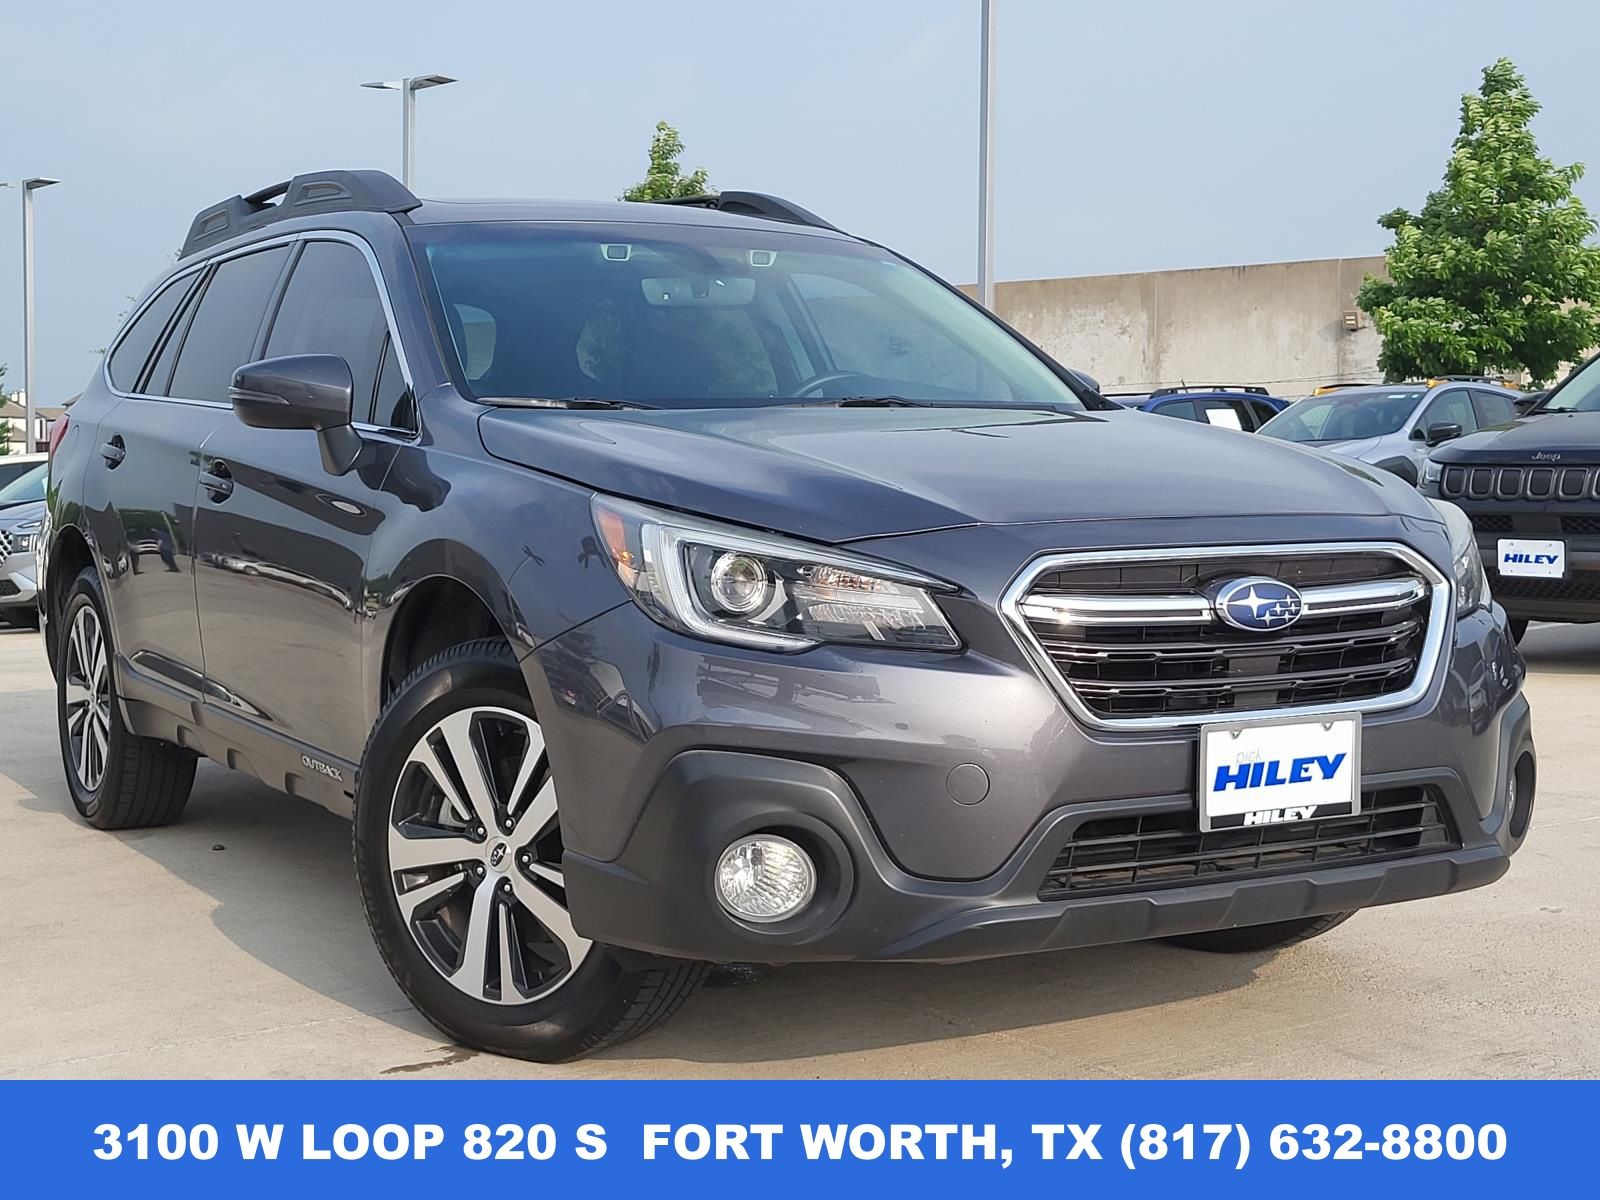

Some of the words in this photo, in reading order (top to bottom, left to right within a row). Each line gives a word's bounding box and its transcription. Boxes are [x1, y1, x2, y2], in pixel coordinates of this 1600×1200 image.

[1503, 553, 1559, 565] HILEY
[302, 755, 343, 782] OUTBACK
[1213, 752, 1348, 792] HILEY
[1243, 804, 1318, 826] HILEY
